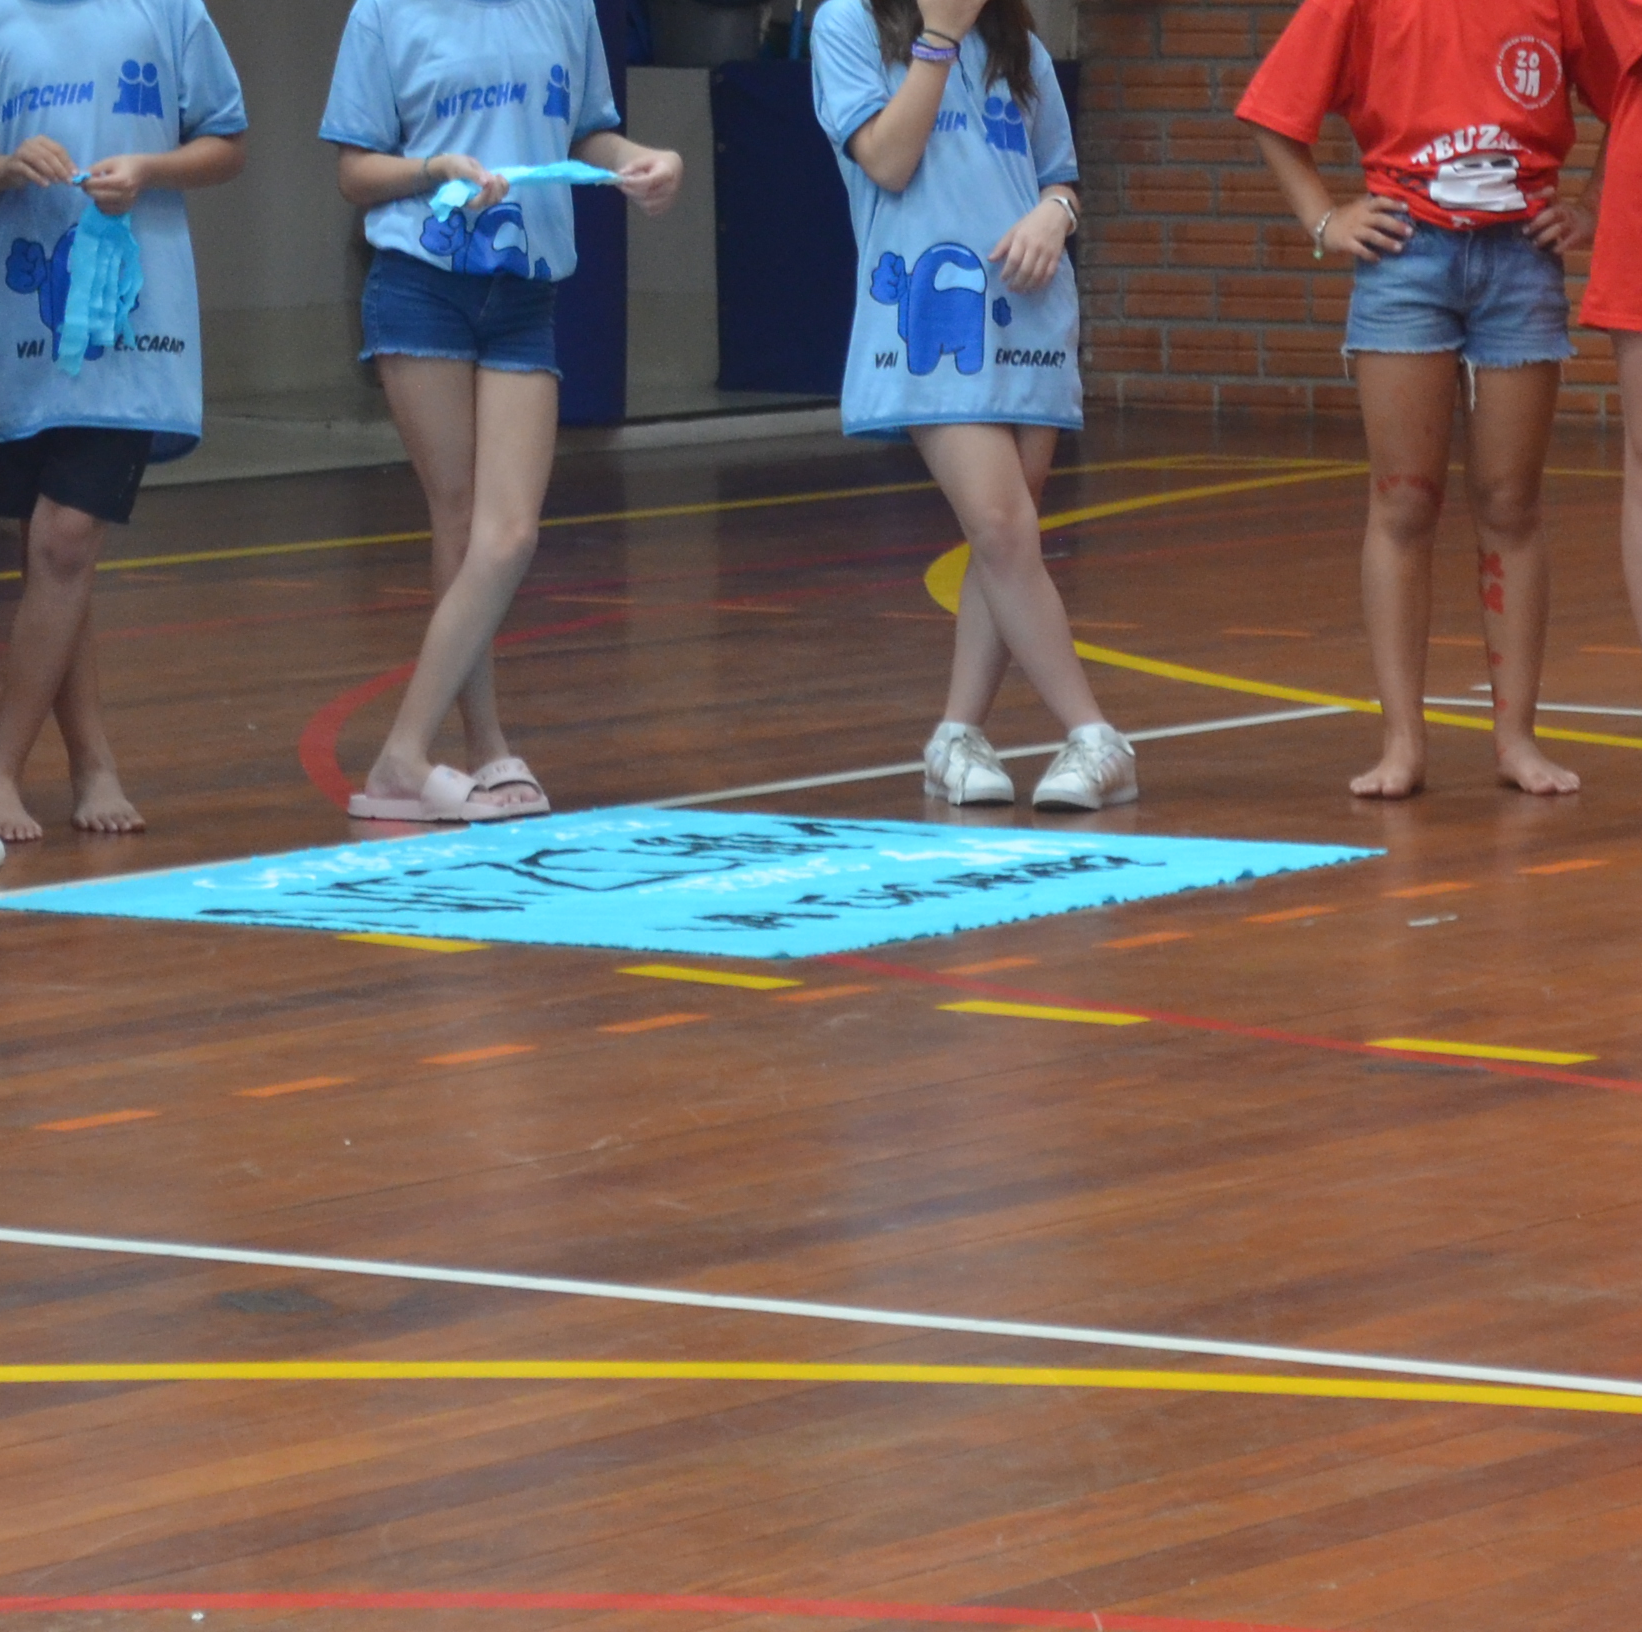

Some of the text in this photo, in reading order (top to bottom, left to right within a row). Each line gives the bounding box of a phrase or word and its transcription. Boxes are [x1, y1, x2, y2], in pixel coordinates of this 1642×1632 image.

[1, 80, 95, 124] NITZCHIM
[17, 338, 45, 359] VAI
[875, 351, 899, 369] VAI
